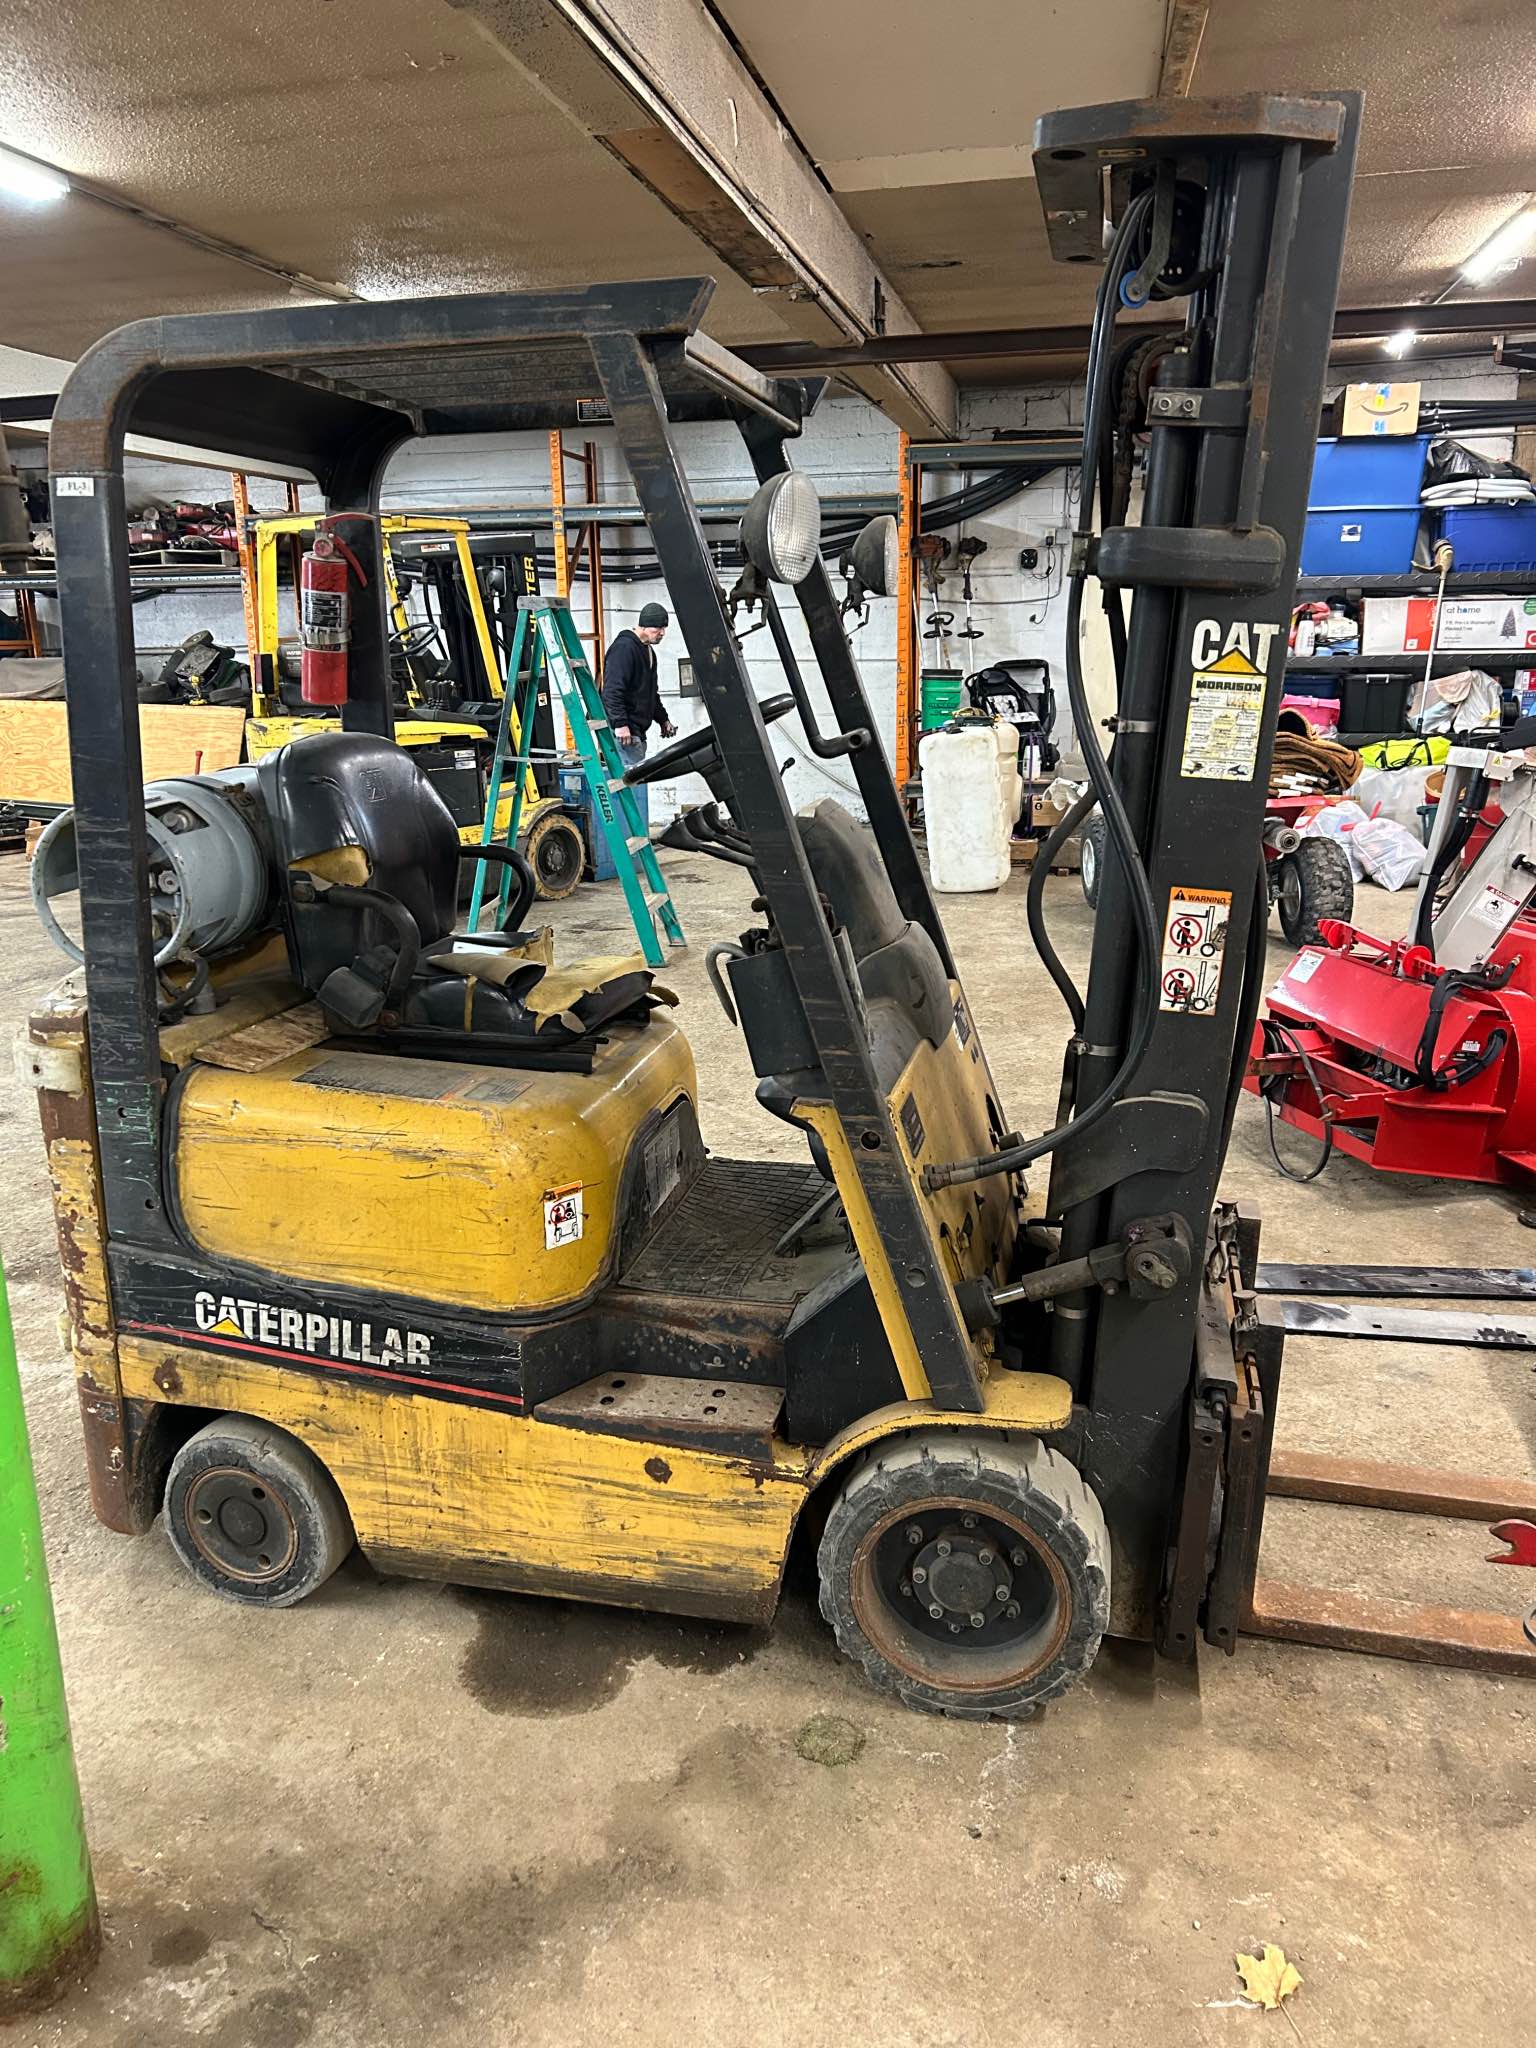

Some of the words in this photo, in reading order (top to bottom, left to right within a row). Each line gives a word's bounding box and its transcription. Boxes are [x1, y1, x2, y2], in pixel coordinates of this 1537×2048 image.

[1457, 606, 1481, 614] home
[1191, 619, 1280, 674] CAT
[1196, 680, 1262, 692] MORRISON
[595, 785, 614, 824] KELLER
[1188, 895, 1227, 904] WARNING
[194, 1291, 432, 1368] CATERPILLAR
